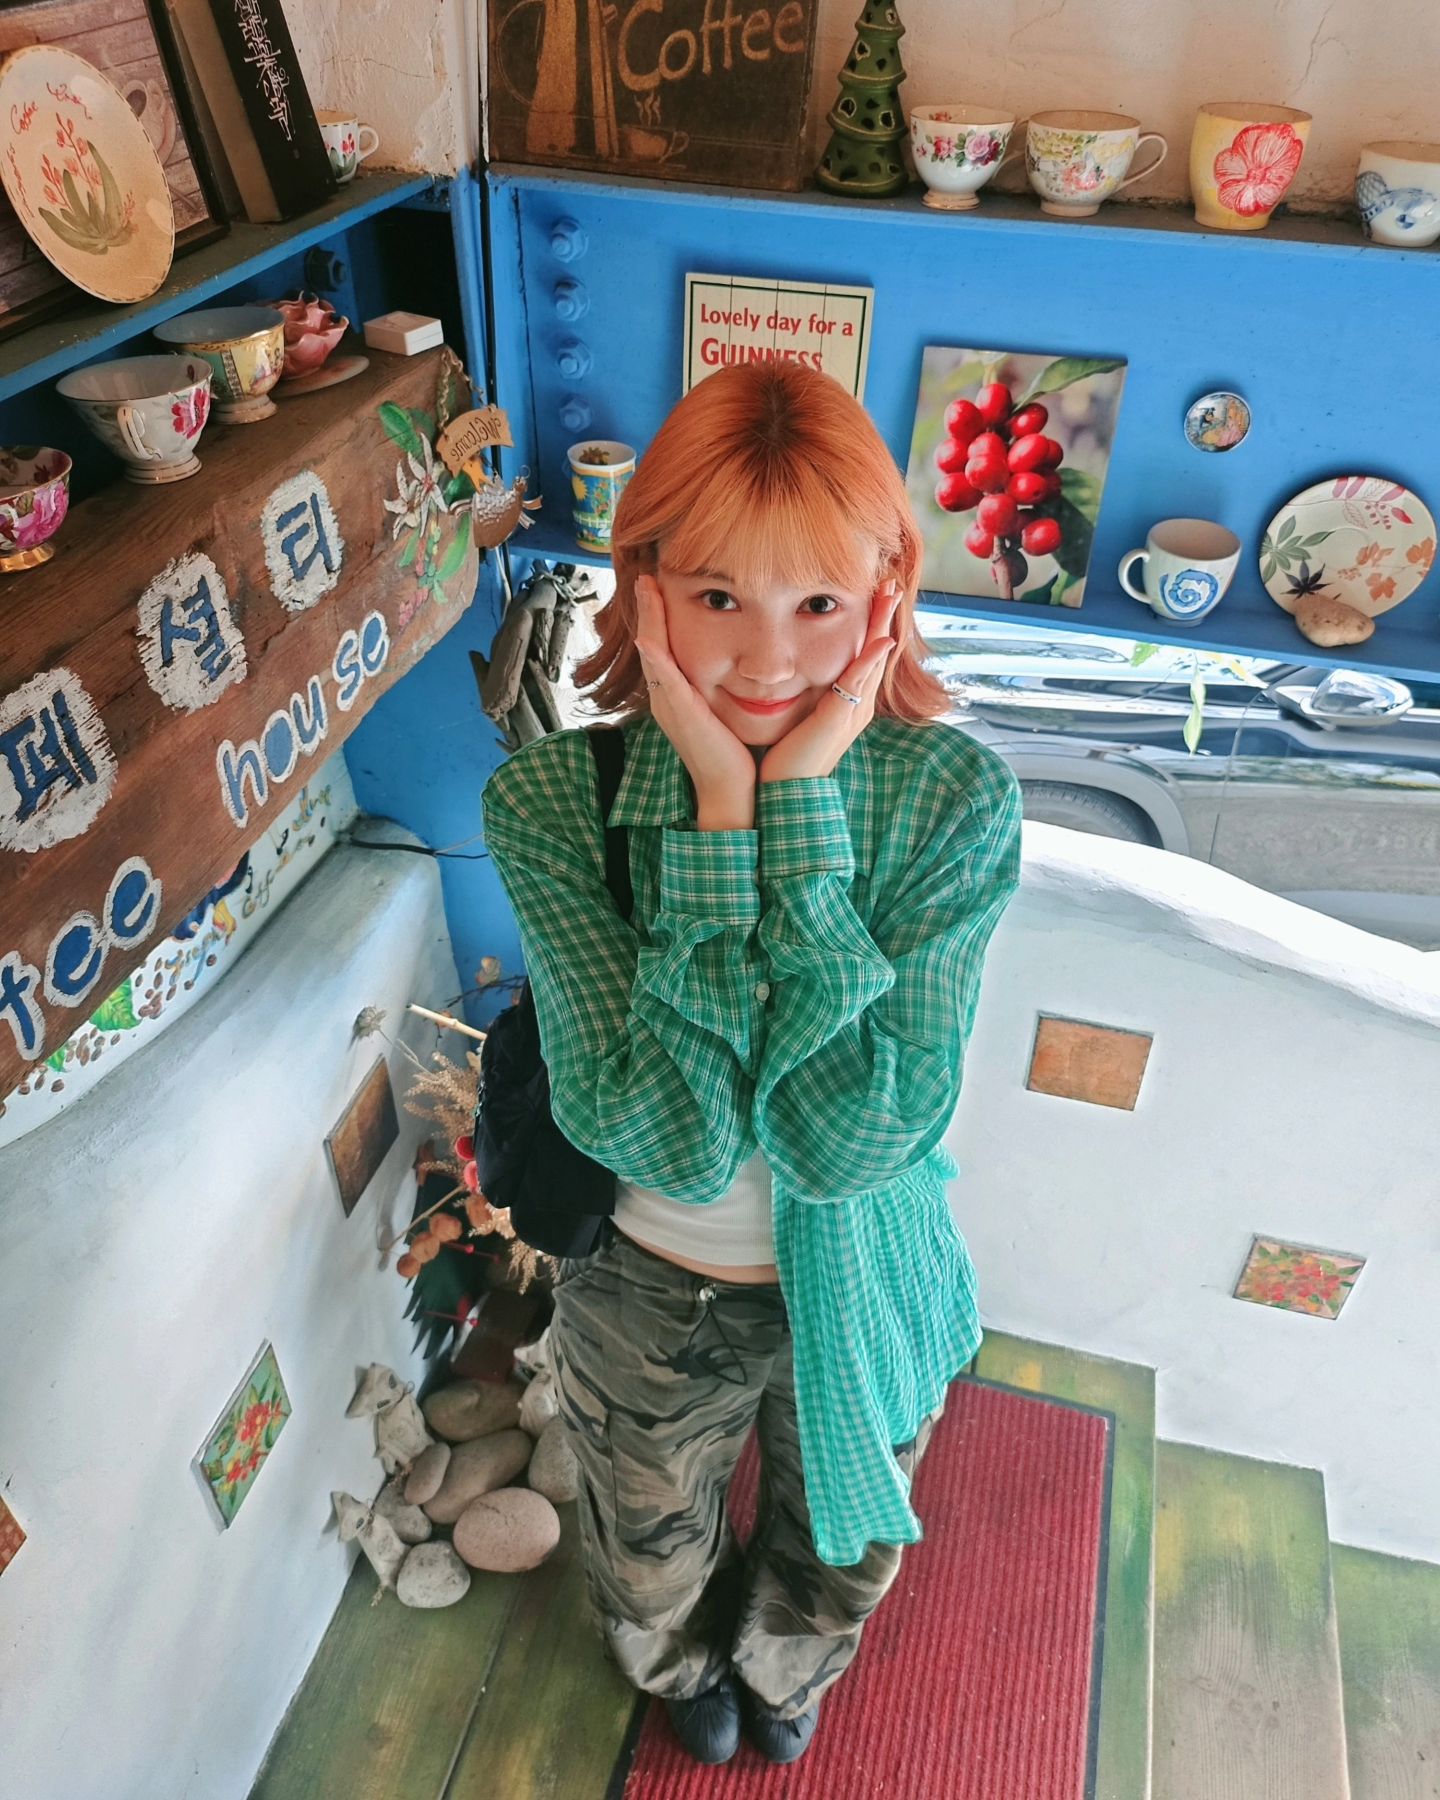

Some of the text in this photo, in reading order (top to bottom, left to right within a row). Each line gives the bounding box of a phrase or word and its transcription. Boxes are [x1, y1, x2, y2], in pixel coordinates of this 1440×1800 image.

[618, 0, 806, 92] Coffee
[701, 303, 853, 337] Lovely day for a
[218, 612, 389, 826] house
